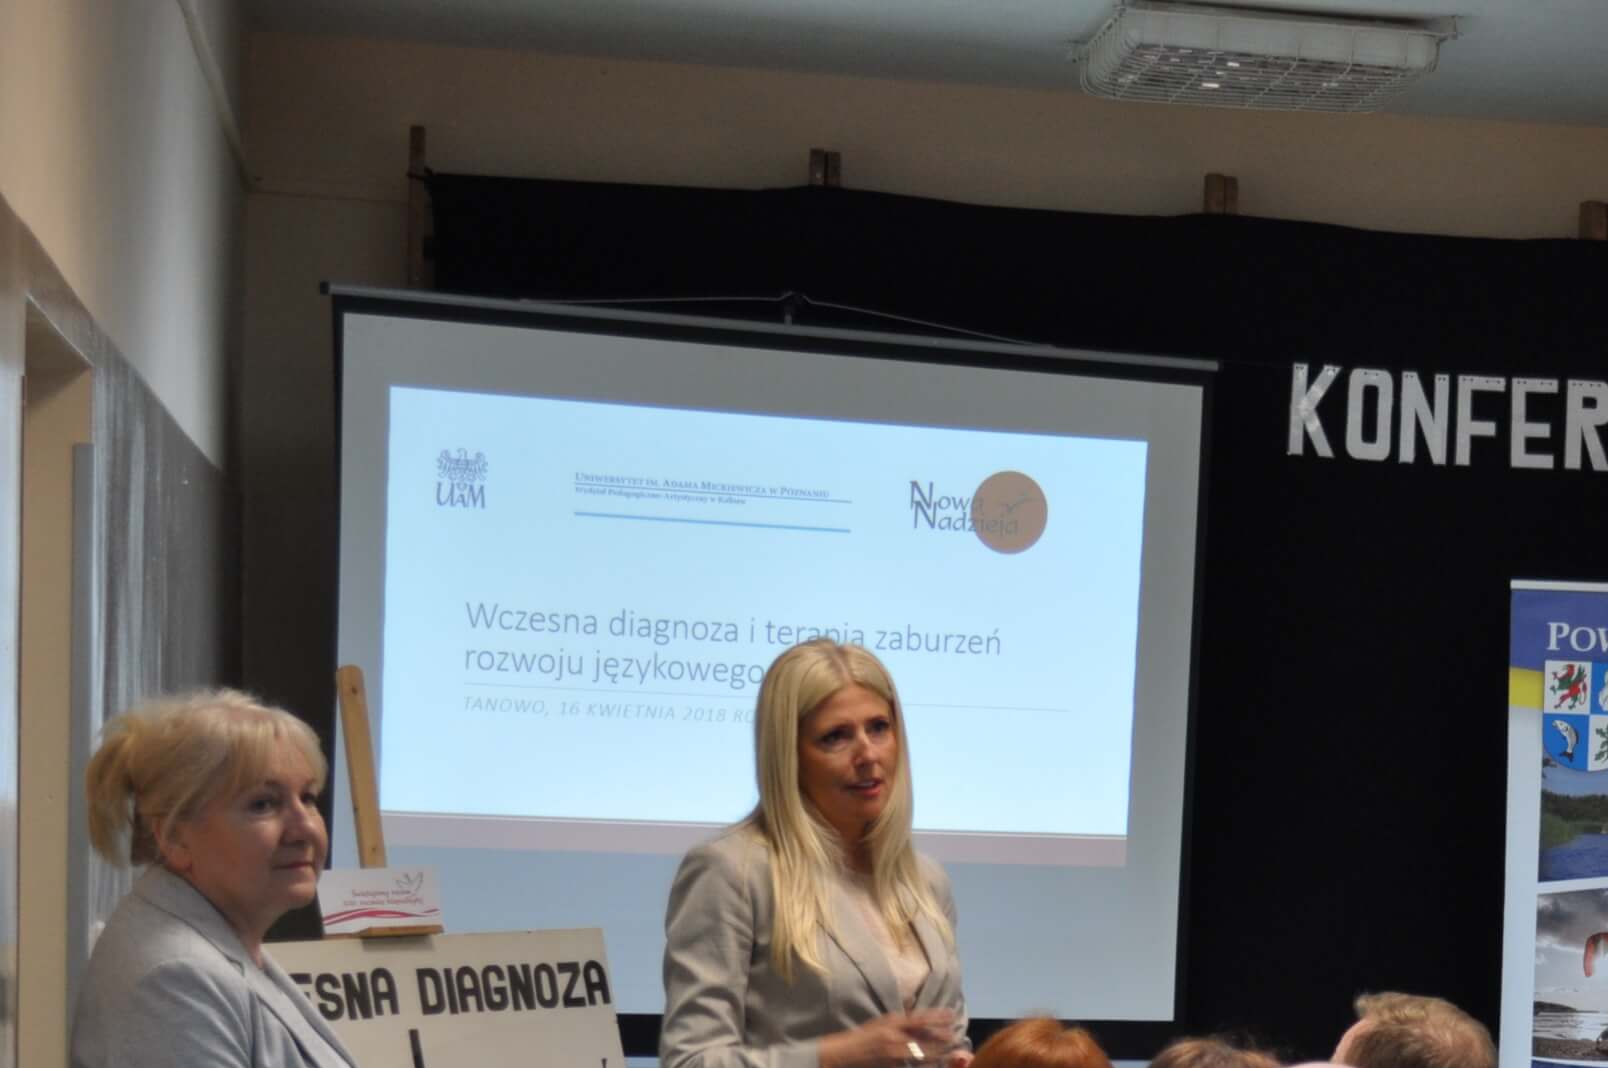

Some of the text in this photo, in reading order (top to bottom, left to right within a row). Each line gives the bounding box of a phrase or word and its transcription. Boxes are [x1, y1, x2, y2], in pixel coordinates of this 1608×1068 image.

[465, 601, 599, 636] Wczesna
[608, 608, 740, 646] diagnoza
[749, 616, 756, 644] i
[875, 624, 1002, 656] zaburzeń
[464, 648, 764, 691] rozwoju językowego
[463, 696, 550, 718] TANOWO,
[587, 702, 676, 721] KWIETNIA
[416, 960, 613, 1016] DIAGNOZA
